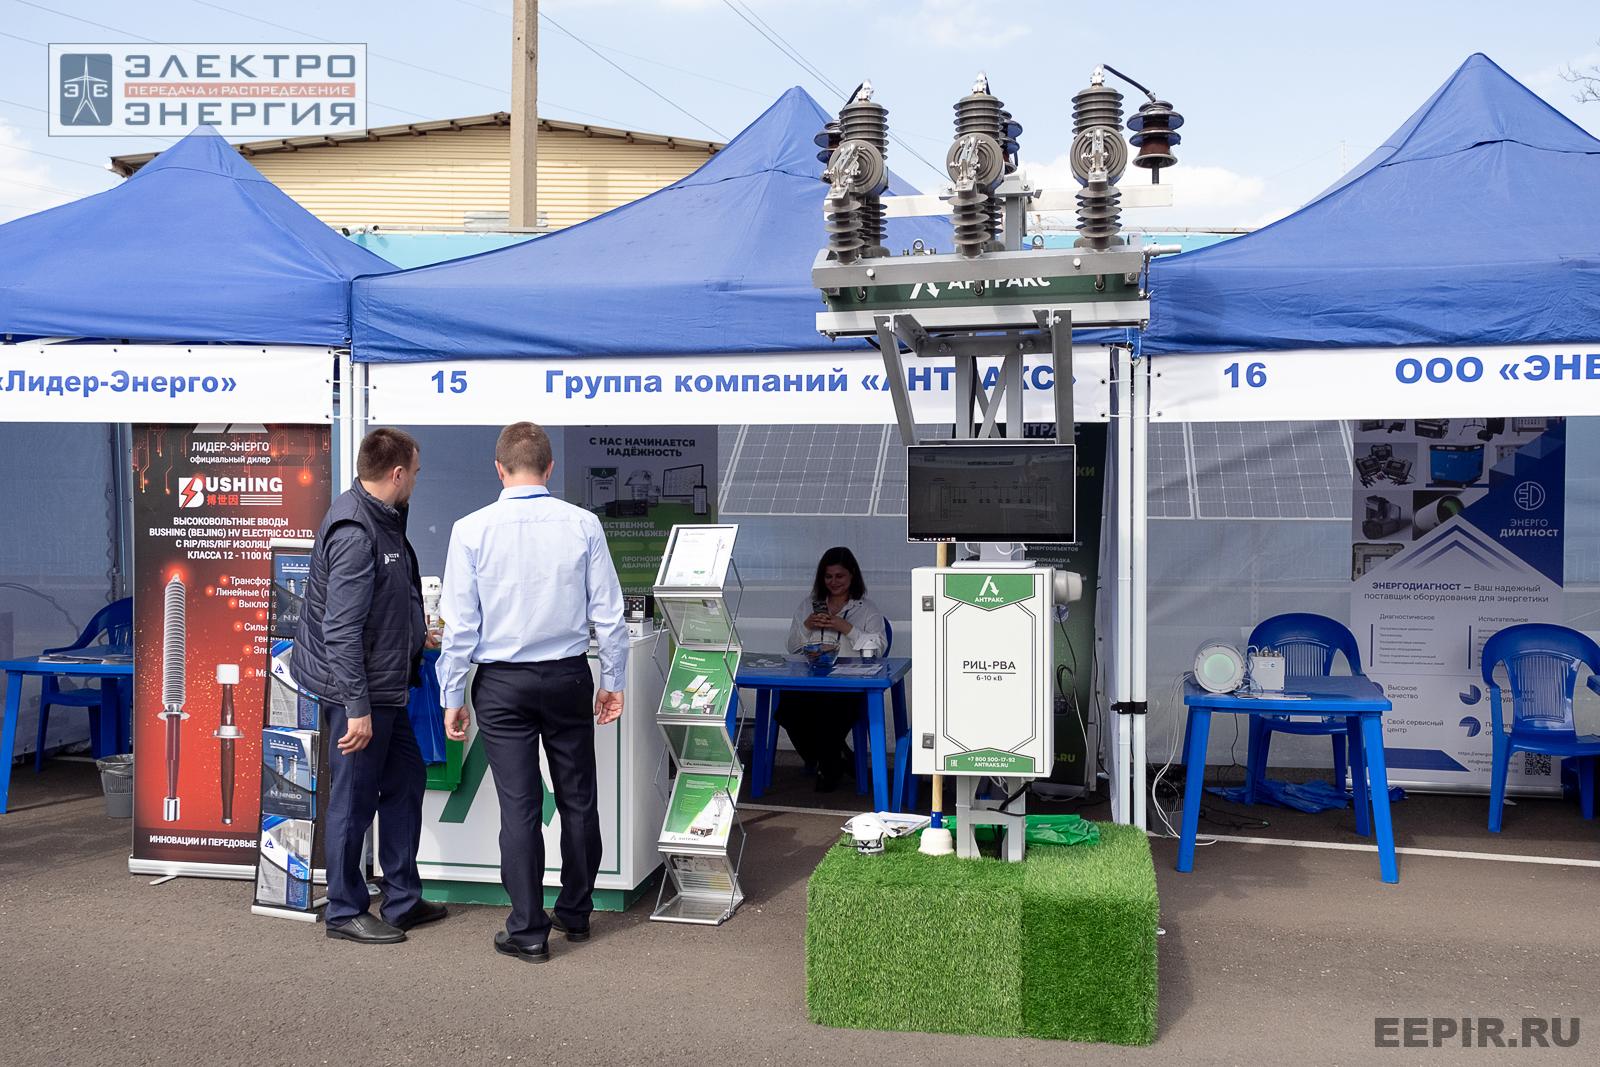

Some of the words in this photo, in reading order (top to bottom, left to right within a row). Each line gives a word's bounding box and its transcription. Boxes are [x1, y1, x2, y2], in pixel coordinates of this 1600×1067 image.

[1224, 362, 1267, 388] 16
[1395, 357, 1484, 384] ООО
[431, 370, 467, 394] 15
[546, 370, 662, 399] Группа
[675, 367, 848, 393] компаний
[589, 437, 596, 445] С
[625, 438, 696, 447] НАЧИНАЕТСЯ
[192, 442, 269, 453] ЛИДЕР-ЭНЕРГО
[606, 448, 682, 457] НАДЁЖНОСТЬ
[173, 517, 255, 525] ВЫСОКОВОЛЬТНЫЕ
[257, 518, 288, 527] ВВОДЫ
[1510, 519, 1549, 527] ЭНЕРГО
[149, 528, 186, 536] BUSHING
[188, 528, 226, 538] (BEIJING)
[228, 529, 240, 537] HV
[242, 529, 281, 537] ELECTRIC
[283, 530, 295, 538] CO
[297, 530, 315, 538] LTD.
[1500, 529, 1559, 538] ДИАГНОСТ
[183, 540, 231, 548] RIP/RIS/RIF
[187, 551, 221, 559] КЛАССА
[223, 551, 234, 559] 12
[216, 588, 259, 596] Линейные
[1372, 583, 1461, 591] ЭНЕРГОДИАГНОСТ
[1495, 585, 1541, 593] надежный
[1413, 594, 1476, 602] оборудования
[963, 661, 1016, 670] РИЦ-РВА
[149, 835, 199, 846] ИННОВАЦИИ
[208, 838, 257, 848] ПЕРЕДОВЫЕ
